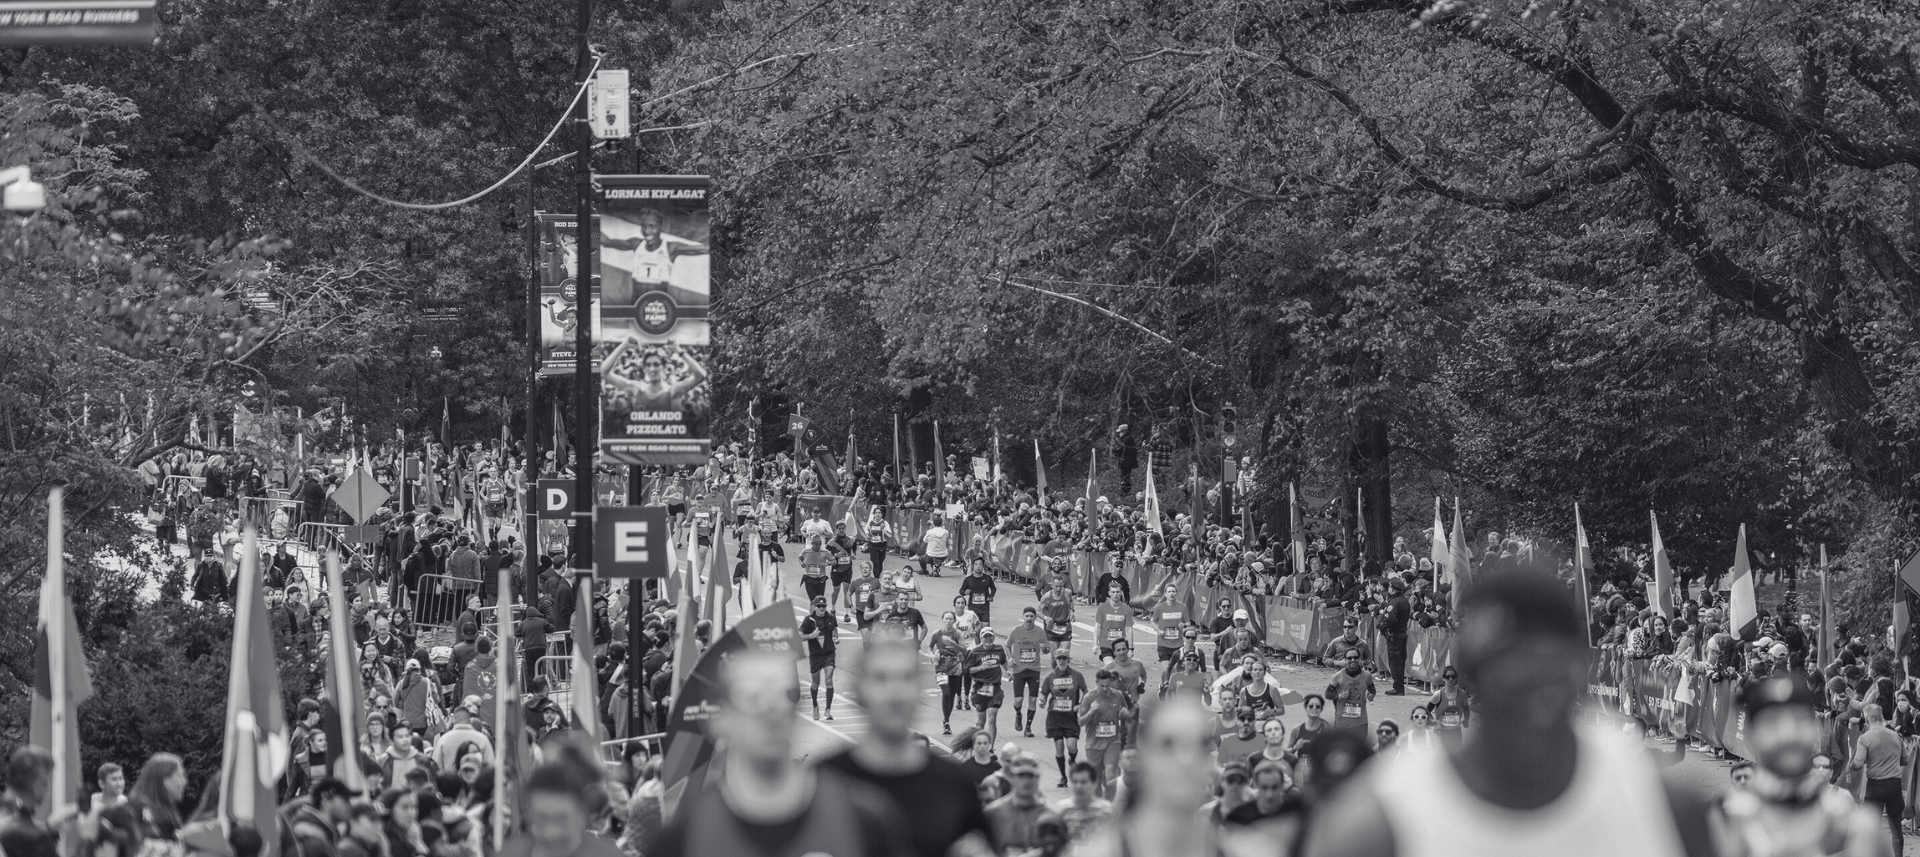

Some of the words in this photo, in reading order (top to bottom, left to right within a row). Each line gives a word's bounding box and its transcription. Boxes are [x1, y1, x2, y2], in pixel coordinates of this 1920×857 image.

[14, 11, 46, 25] YORK
[47, 11, 82, 25] ROAD
[83, 9, 139, 23] RUNNERS
[604, 189, 650, 199] LORNAH
[651, 189, 706, 199] KIPLAGAT
[646, 267, 651, 277] 1
[630, 411, 682, 421] ORLANDO
[626, 424, 687, 435] PIZZOLATO
[791, 422, 803, 430] 26
[546, 488, 568, 511] D
[614, 521, 649, 563] E
